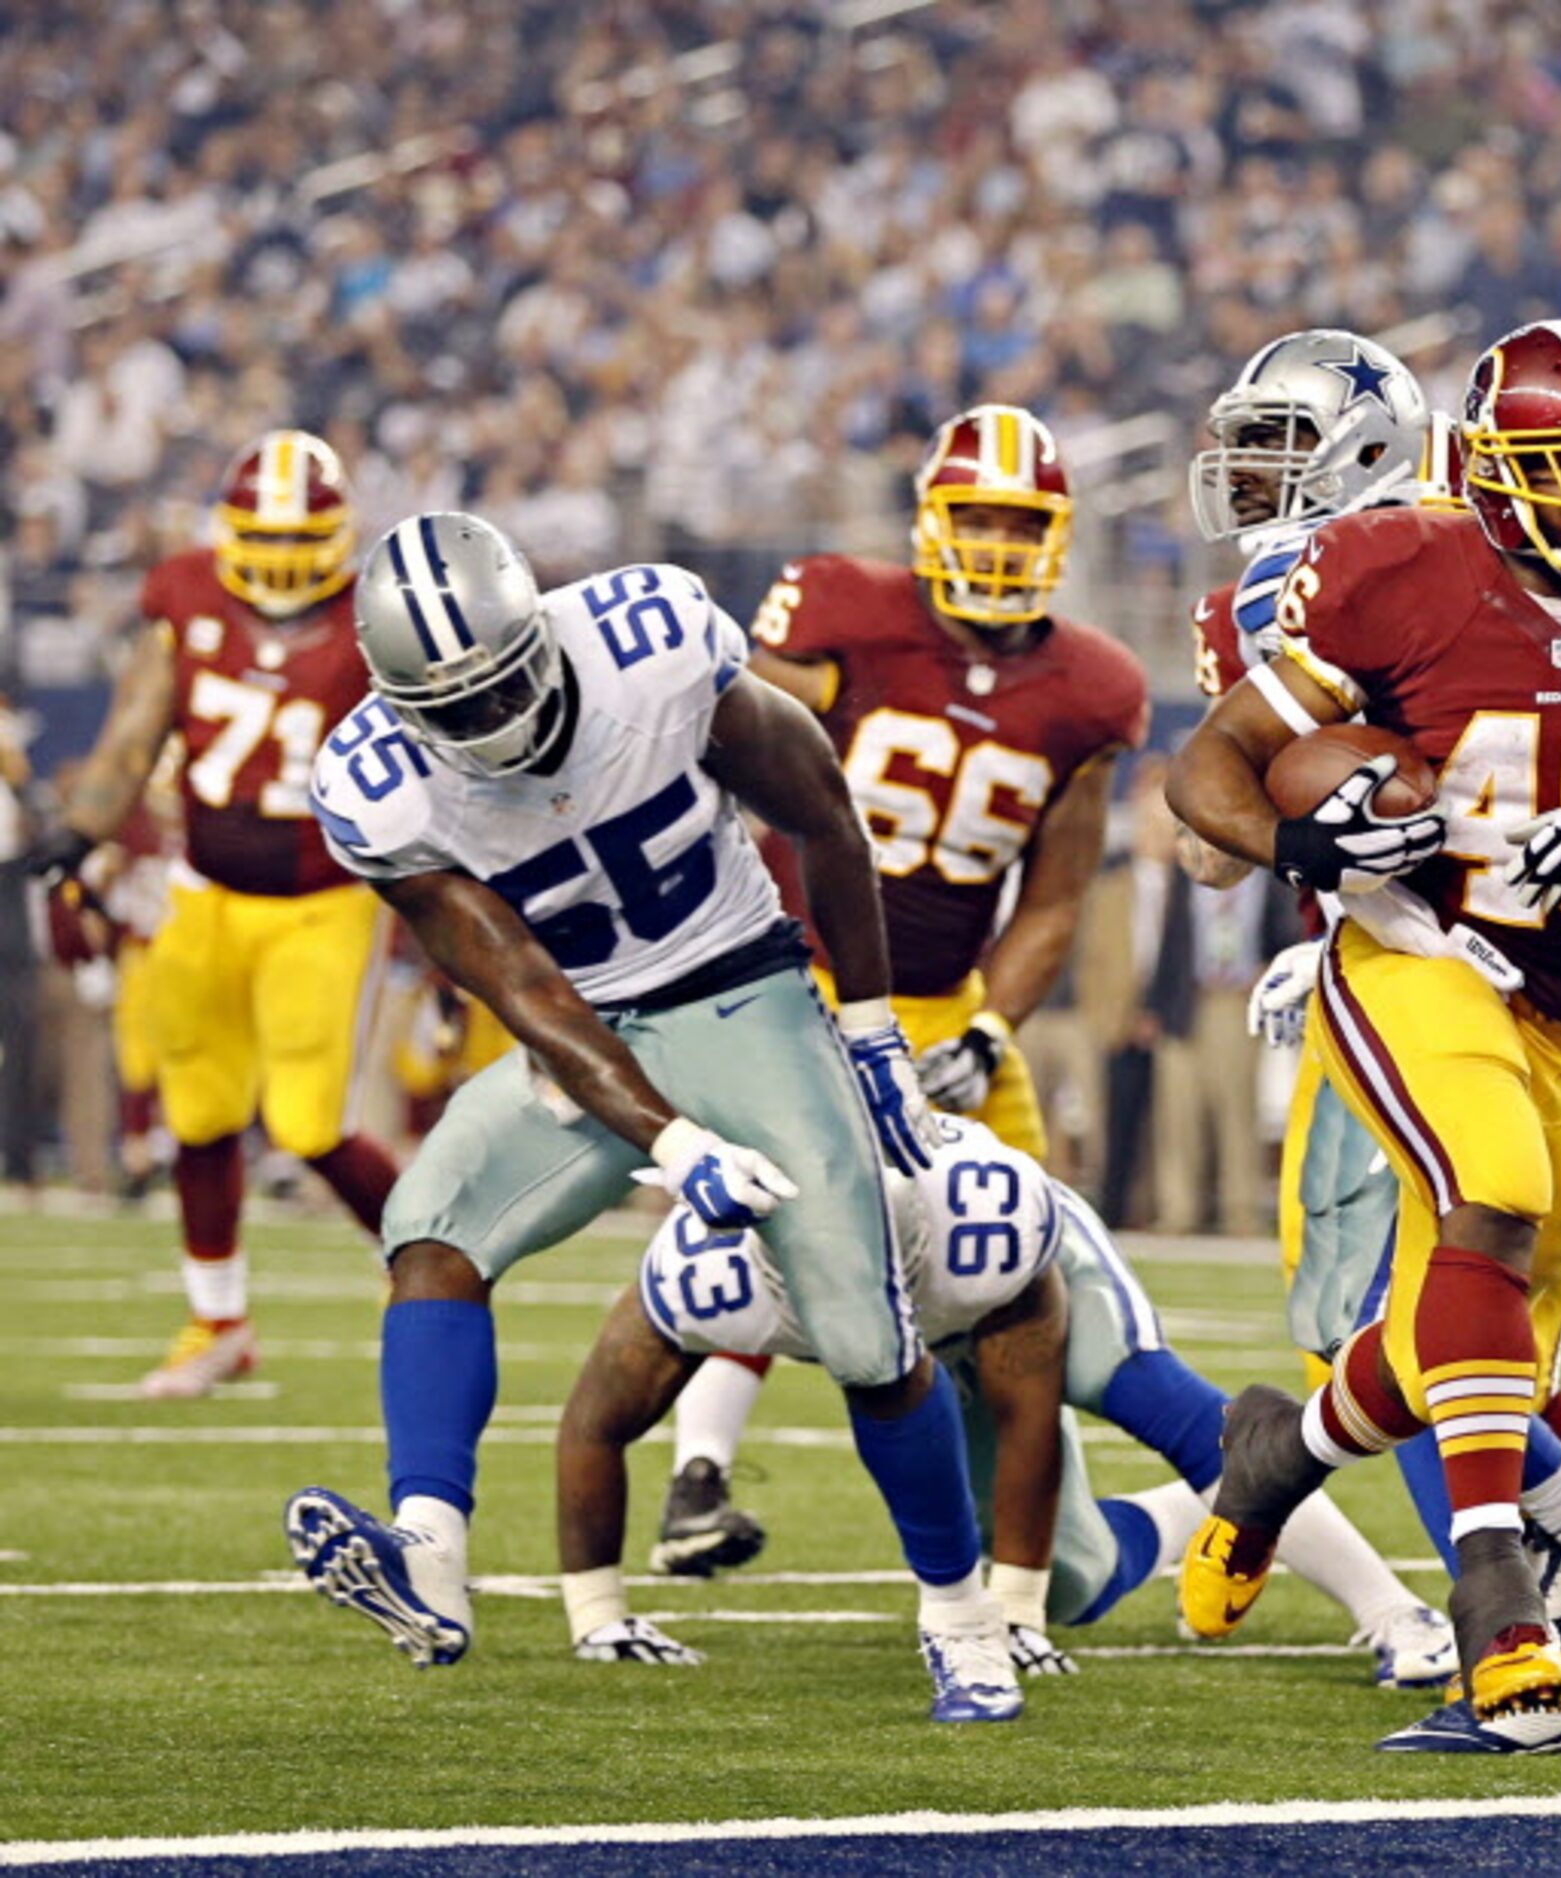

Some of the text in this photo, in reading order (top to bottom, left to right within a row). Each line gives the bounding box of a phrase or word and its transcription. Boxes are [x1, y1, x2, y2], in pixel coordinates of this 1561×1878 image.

[581, 566, 684, 670] 55
[188, 668, 325, 818] 71
[327, 695, 430, 801] 55
[845, 707, 1054, 884] 66
[948, 1160, 1020, 1276] 93
